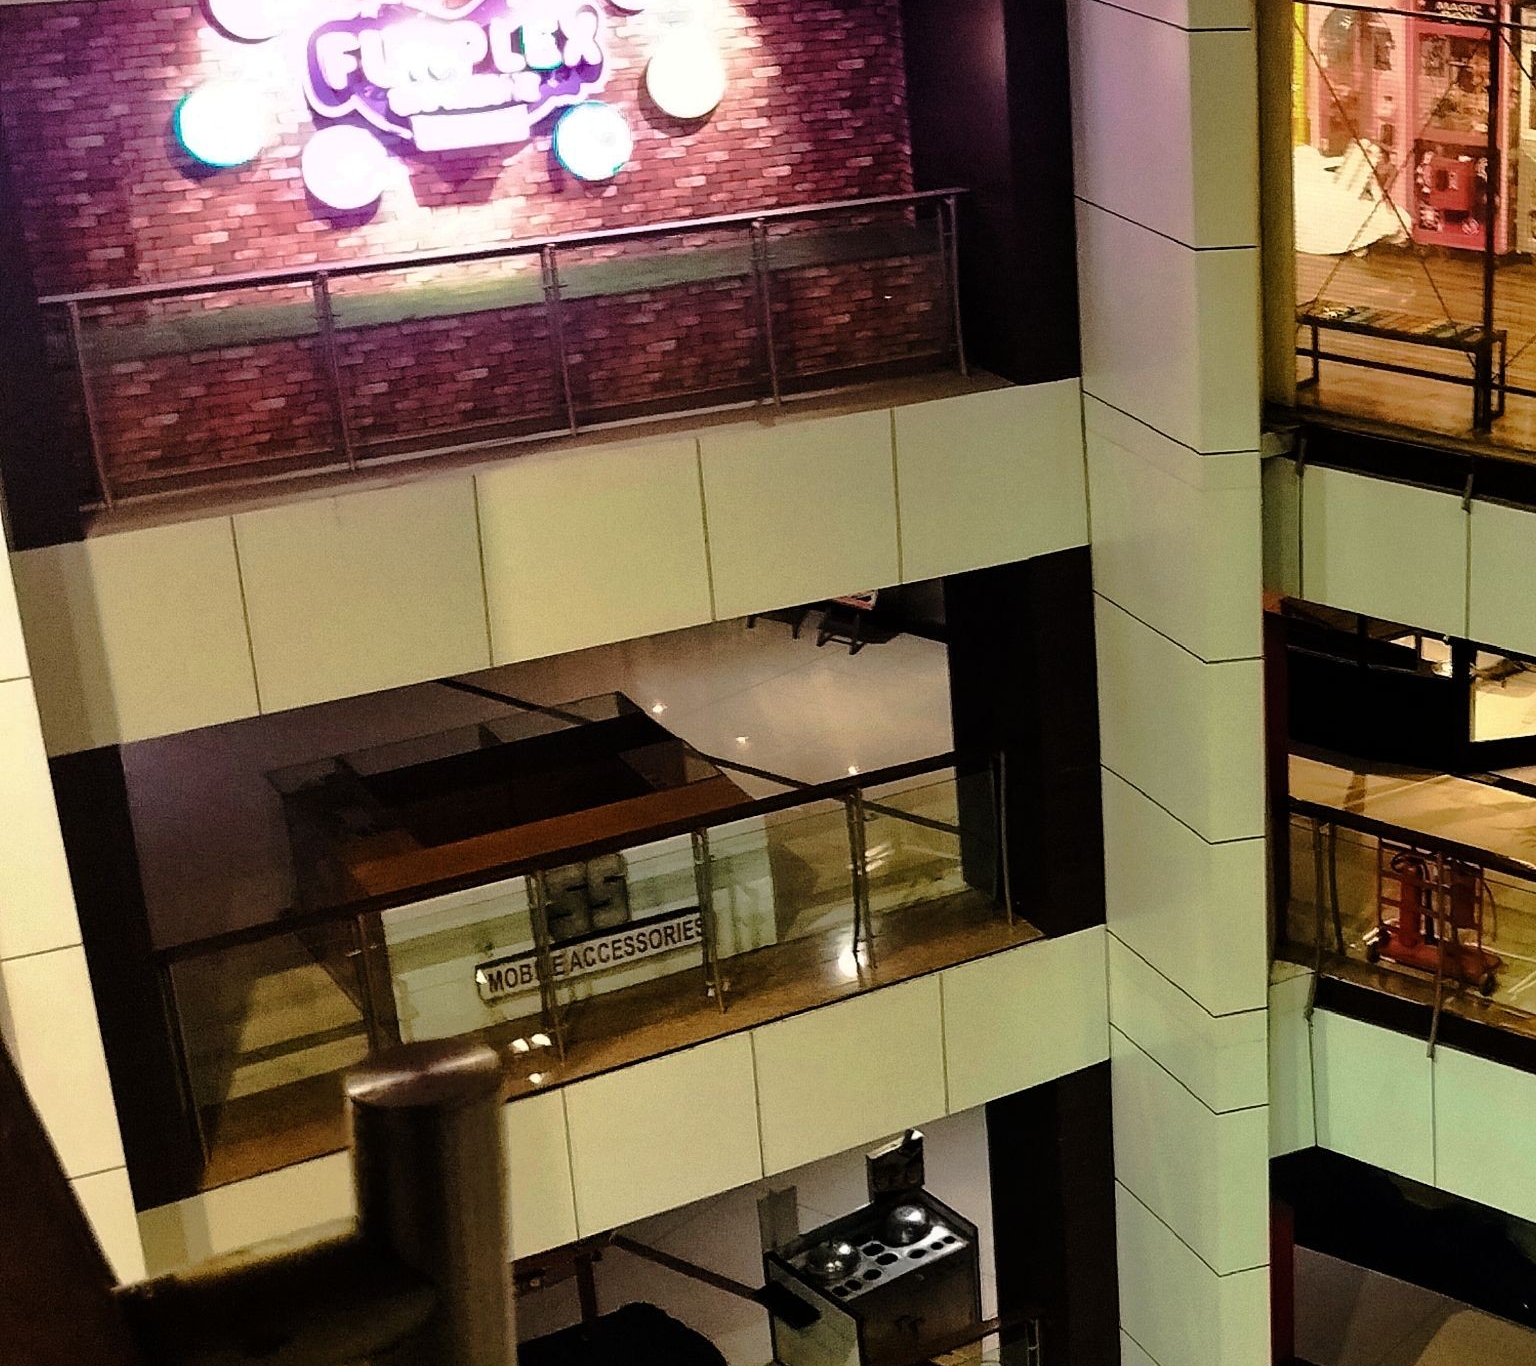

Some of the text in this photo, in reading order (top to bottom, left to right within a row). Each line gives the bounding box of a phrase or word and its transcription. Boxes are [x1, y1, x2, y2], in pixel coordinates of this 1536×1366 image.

[1434, 1, 1484, 16] MAGIC
[487, 917, 705, 993] MOBIE ACCESSORIES
